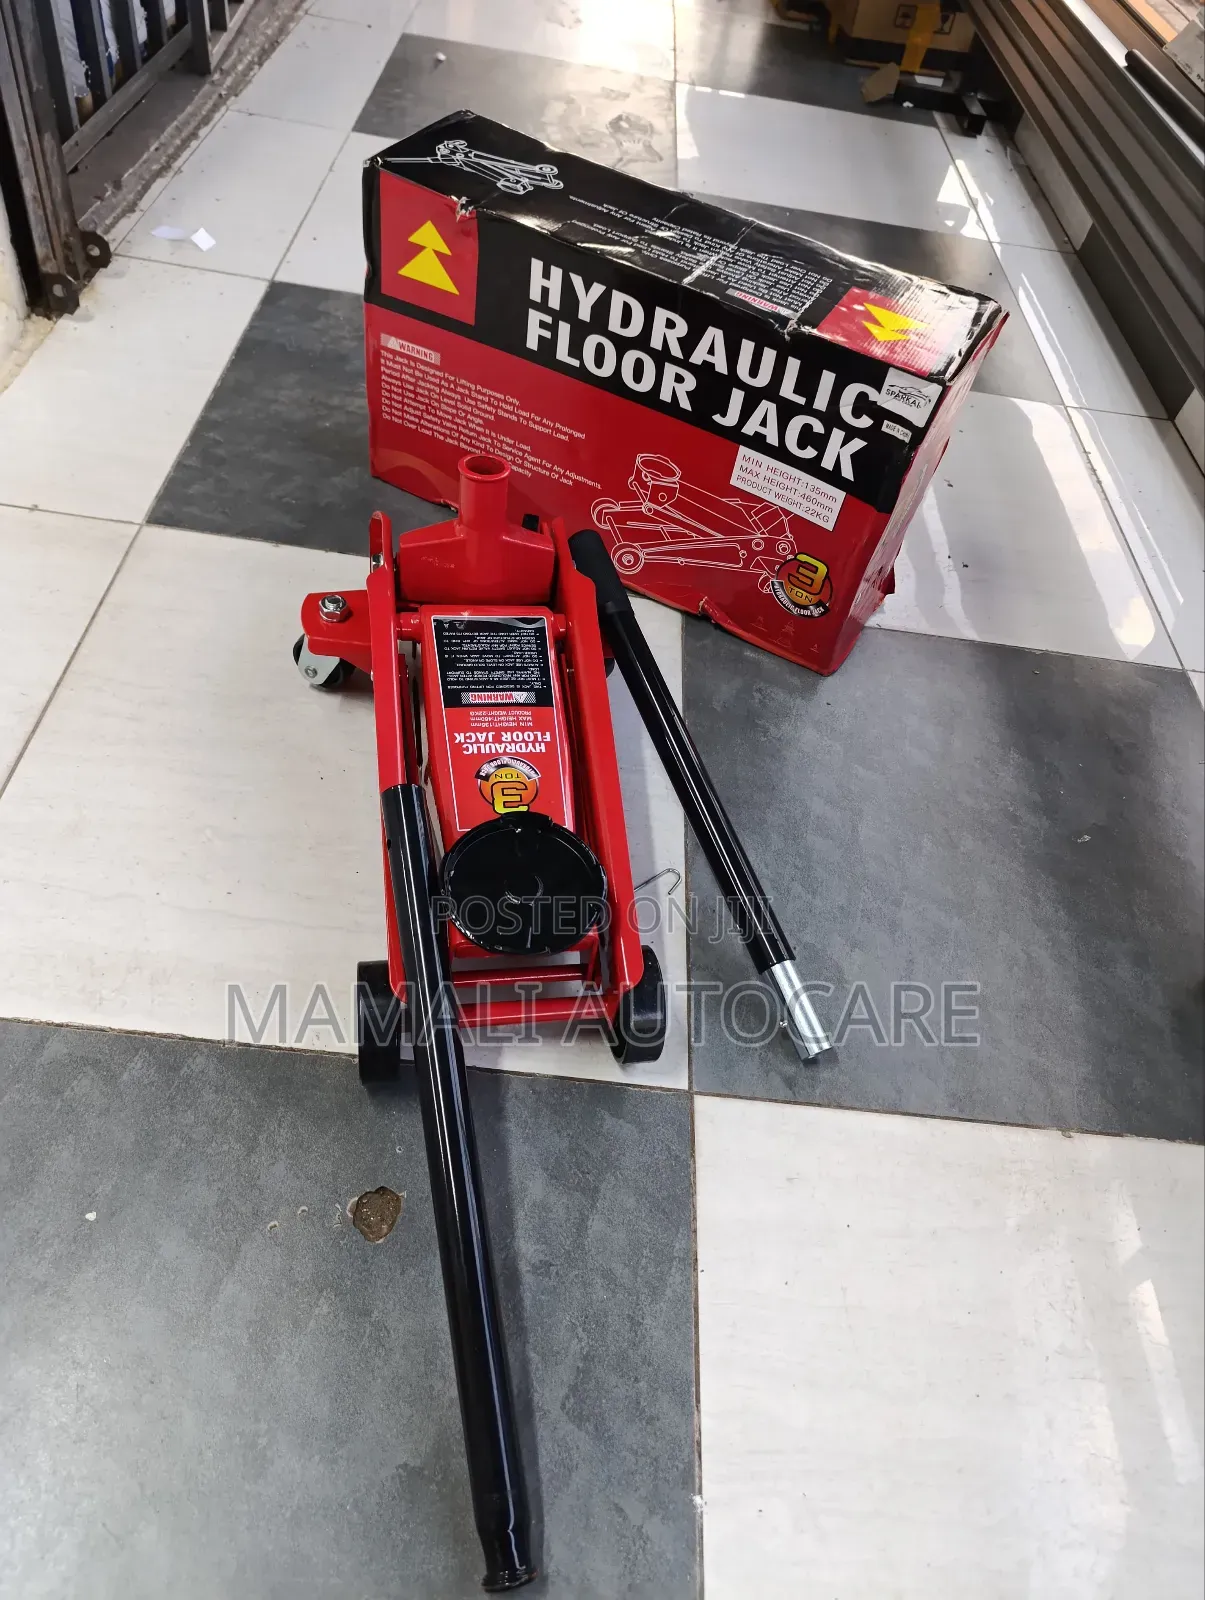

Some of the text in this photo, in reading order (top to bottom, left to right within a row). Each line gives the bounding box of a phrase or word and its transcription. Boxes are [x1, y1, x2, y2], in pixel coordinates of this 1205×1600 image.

[398, 340, 434, 362] WARNING
[529, 256, 878, 430] HYDRAULIC
[380, 349, 393, 359] This
[394, 354, 408, 365] Jack
[416, 362, 443, 379] Designed
[444, 372, 454, 381] For
[456, 377, 475, 390] Lifting
[476, 384, 504, 401] Purposes
[505, 394, 520, 406] Only.
[385, 359, 400, 370] Must
[402, 365, 413, 375] Not
[424, 373, 439, 384] Used
[456, 385, 469, 395] Jack
[470, 390, 488, 402] Stand
[499, 400, 513, 411] Hold
[514, 406, 529, 417] Load
[530, 412, 541, 422] For
[541, 416, 553, 428] Any
[554, 422, 585, 440] Prolonged
[525, 307, 868, 482] FLOOR JACK
[380, 366, 400, 378] Period
[401, 373, 415, 384] After
[417, 379, 439, 394] Jacking
[440, 387, 461, 402] Always
[464, 396, 475, 406] Use
[476, 401, 496, 415] Safety
[497, 408, 517, 421] Stands
[528, 420, 551, 435] Support
[552, 430, 569, 442] Load.
[736, 475, 830, 523] PRODUCT WEIGHT:22KG
[739, 464, 834, 513] MAX HEIGHT:460mm
[742, 454, 838, 504] MIN HEIGHT:135mm
[788, 553, 829, 595] 3
[789, 586, 813, 603] TON
[469, 693, 514, 702] WARNING
[453, 730, 551, 742] FLOOR JACK
[461, 741, 545, 754] HYDRAULIC
[488, 780, 529, 814] 3
